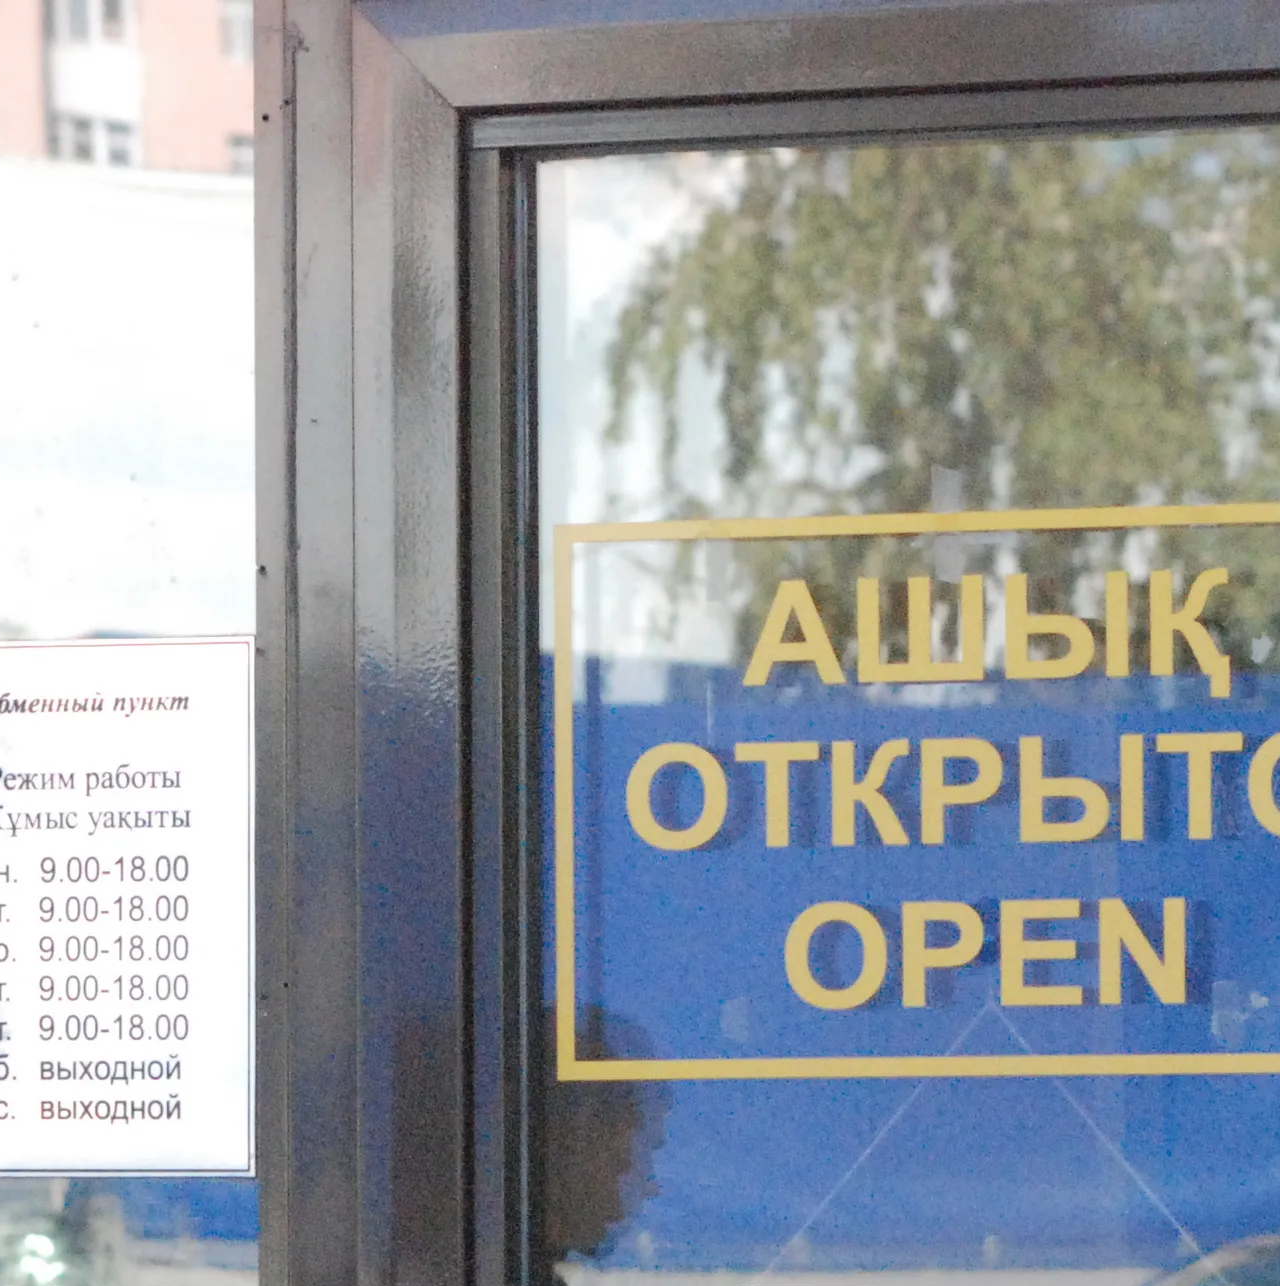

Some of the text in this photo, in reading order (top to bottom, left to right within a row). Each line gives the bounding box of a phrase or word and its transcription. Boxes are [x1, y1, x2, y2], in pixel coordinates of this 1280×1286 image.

[741, 565, 1232, 700] АШЫҚ
[112, 694, 191, 719] пункт
[84, 763, 182, 798] работы
[86, 808, 192, 836] уақыты
[38, 854, 190, 884] 9.00-18.00
[38, 894, 190, 923] 9.00-18.00
[38, 934, 190, 962] 9.00-18.00
[783, 895, 1188, 1011] OPEN
[38, 973, 190, 1002] 9.00-18.00
[38, 1013, 190, 1042] 9.00-18.00
[38, 1053, 182, 1086] выходной
[38, 1092, 182, 1125] выходной
